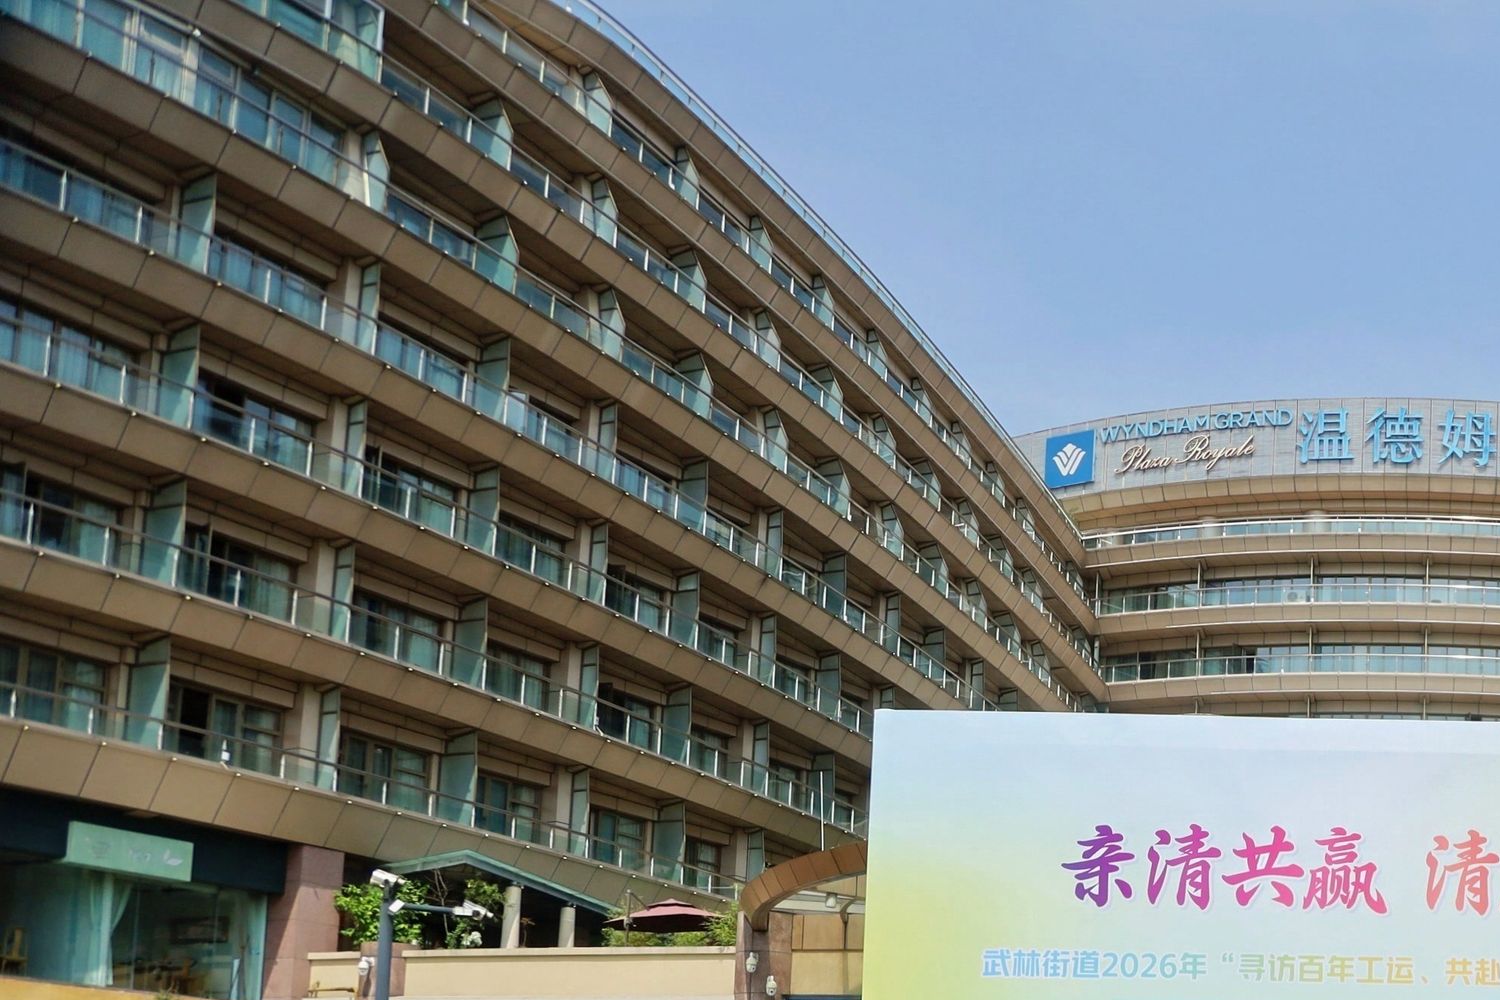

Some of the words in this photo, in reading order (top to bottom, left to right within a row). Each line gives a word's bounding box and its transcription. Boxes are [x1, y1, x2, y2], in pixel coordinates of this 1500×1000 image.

[1100, 415, 1211, 443] WYNDHAM
[1214, 409, 1293, 430] GRAND
[1114, 444, 1173, 474] Plaza
[1173, 434, 1256, 470] Royale
[1061, 823, 1388, 914] 亲清共赢
